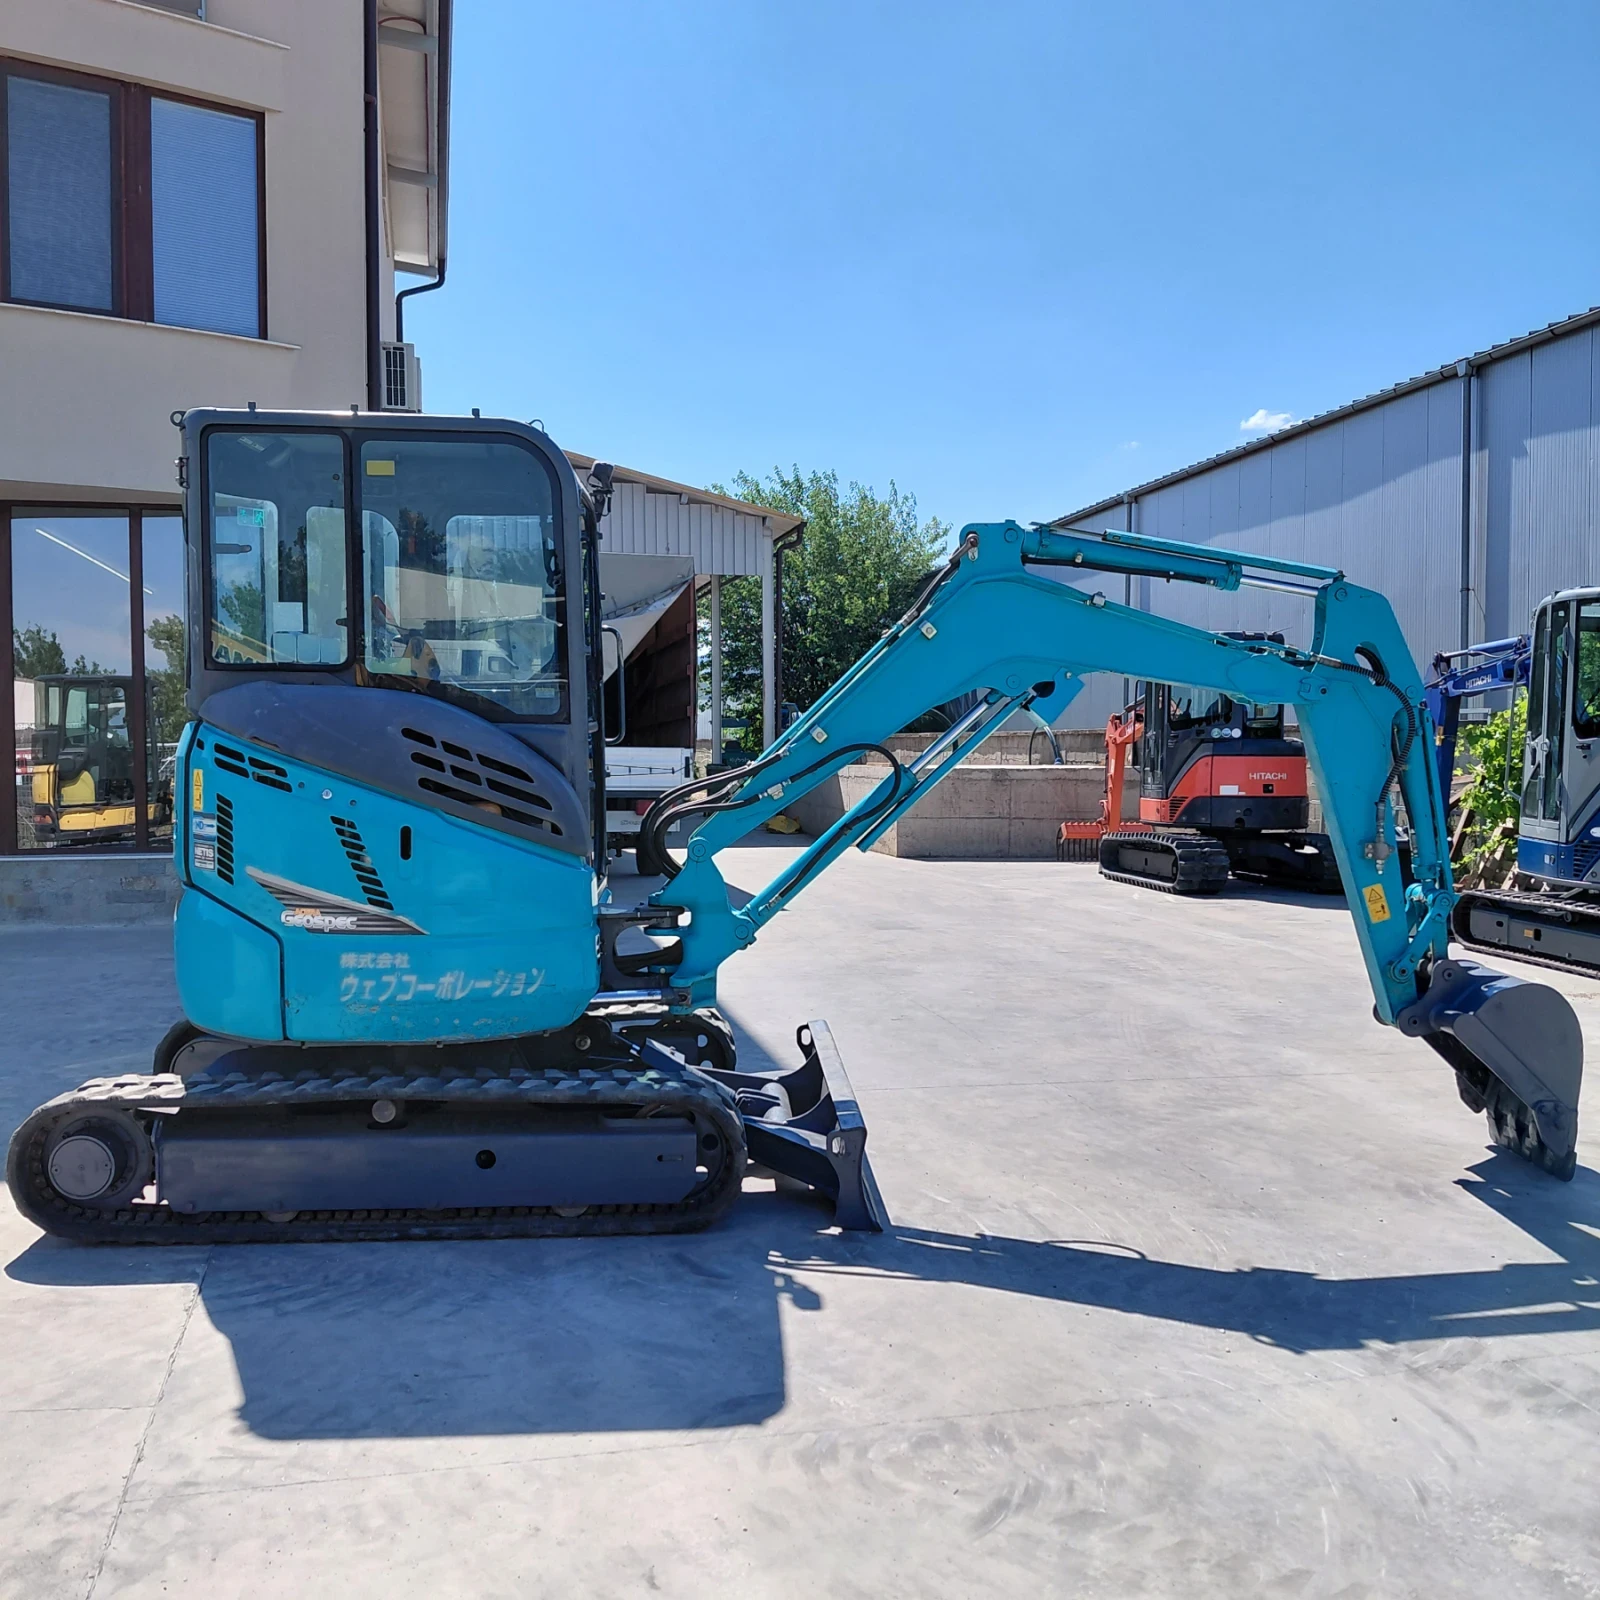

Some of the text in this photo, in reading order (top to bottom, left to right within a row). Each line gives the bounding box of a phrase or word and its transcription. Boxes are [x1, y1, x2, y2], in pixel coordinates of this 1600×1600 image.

[1465, 674, 1492, 688] HITACHI
[1248, 772, 1287, 780] HITACHI
[340, 952, 410, 968] 株式会社
